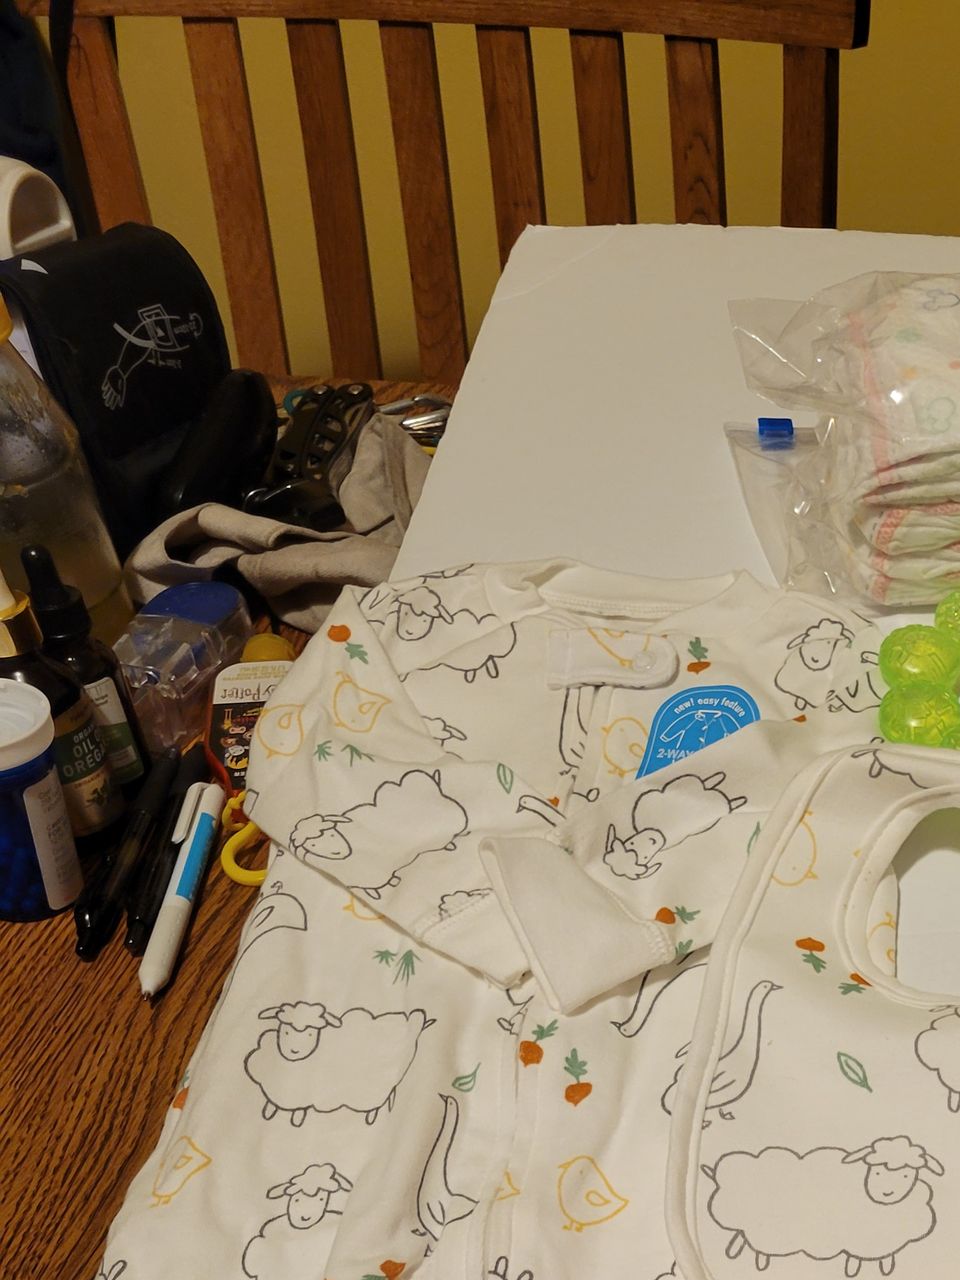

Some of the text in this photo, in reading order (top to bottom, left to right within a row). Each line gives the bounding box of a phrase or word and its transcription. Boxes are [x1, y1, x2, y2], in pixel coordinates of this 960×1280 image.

[673, 696, 746, 718] new! easy feature
[73, 738, 95, 758] OIL
